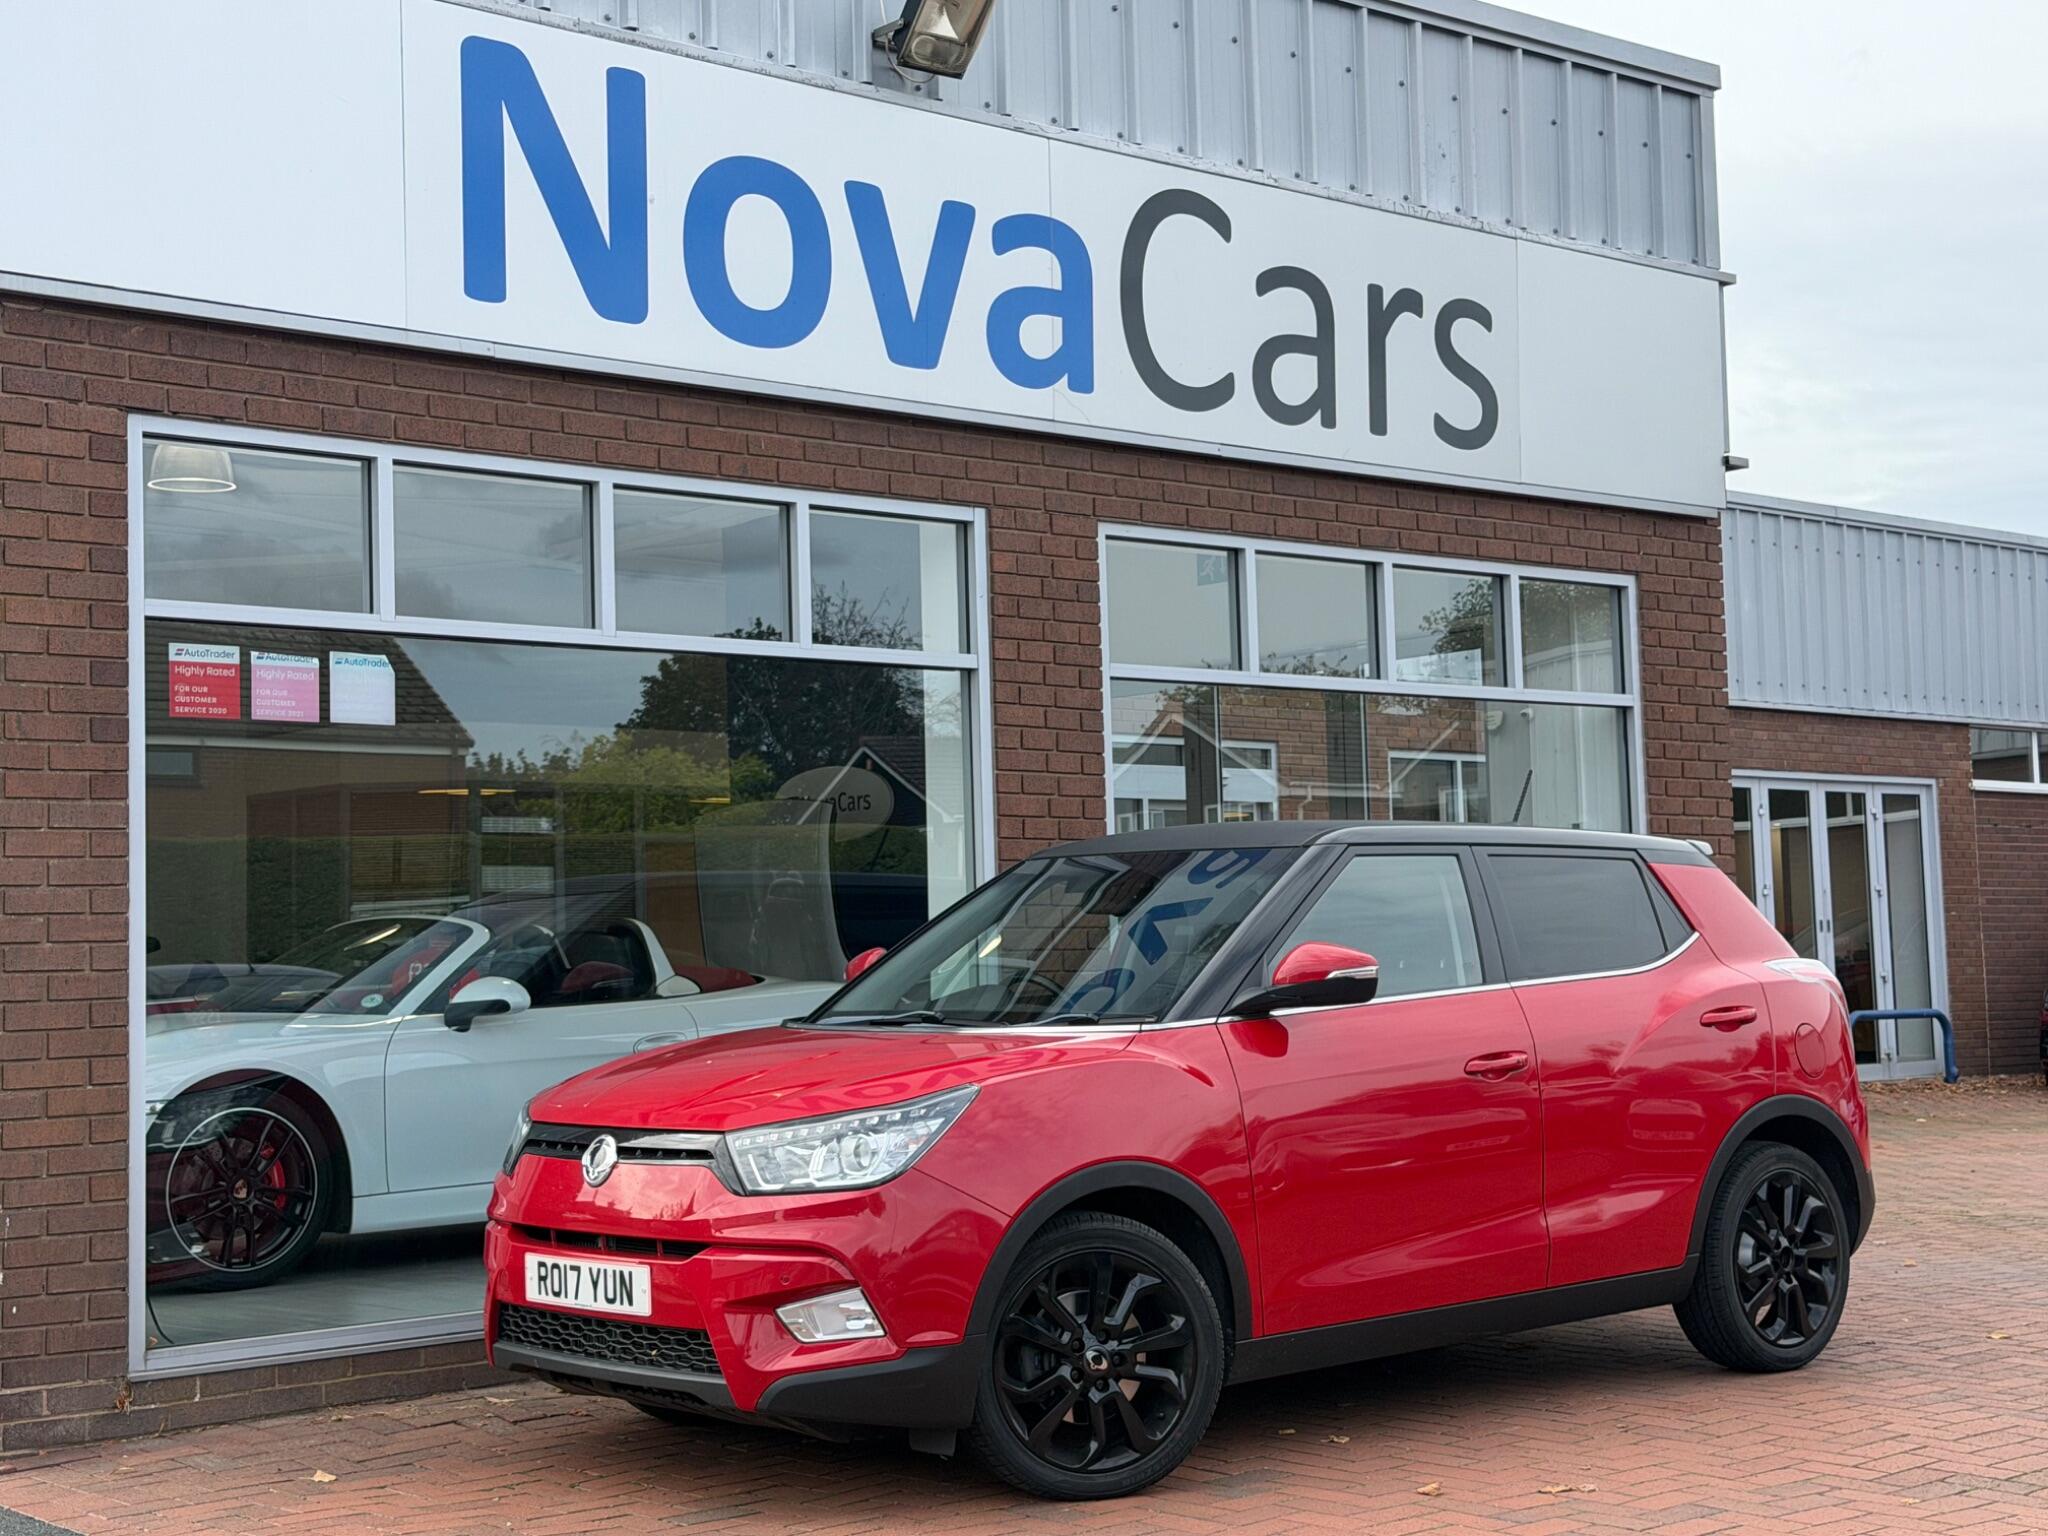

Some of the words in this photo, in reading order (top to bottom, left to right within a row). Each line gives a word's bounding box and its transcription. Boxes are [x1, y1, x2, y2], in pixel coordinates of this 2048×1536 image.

[184, 648, 235, 659] AutoTrader
[175, 665, 205, 677] Highly
[206, 667, 235, 677] Rated
[256, 669, 286, 680] Highly
[287, 671, 314, 681] Rated
[537, 1261, 581, 1300] RO17
[588, 1267, 633, 1307] YUN
